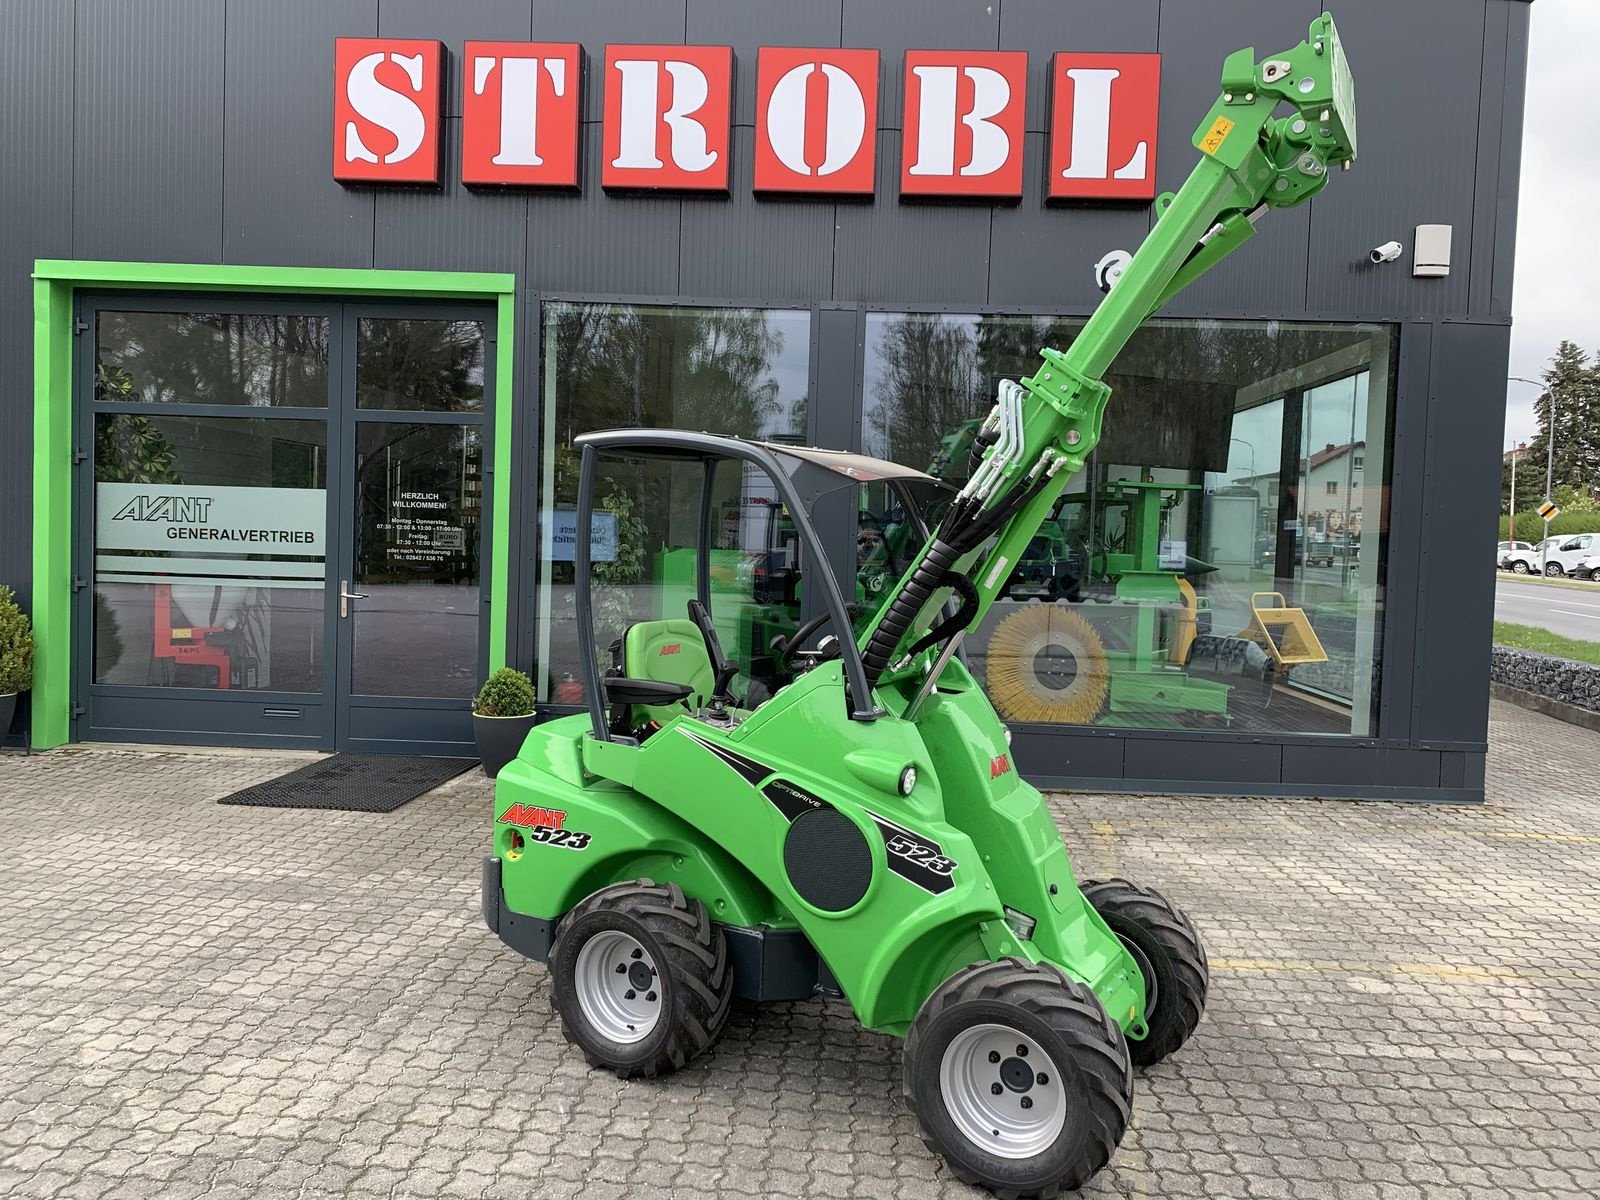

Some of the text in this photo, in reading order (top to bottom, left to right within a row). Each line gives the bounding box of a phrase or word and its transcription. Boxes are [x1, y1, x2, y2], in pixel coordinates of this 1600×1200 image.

[346, 52, 1148, 179] STROBL
[112, 495, 212, 523] AVANT
[392, 501, 447, 509] WILLKOMMEN!
[401, 492, 439, 500] HERZLICH
[391, 517, 412, 525] Montag
[166, 527, 315, 543] GENERALVERTRIEB
[414, 549, 451, 557] Vereinbarung
[771, 780, 822, 808] OPTIDRIVE
[496, 802, 567, 830] AVANT
[530, 824, 593, 851] 523
[886, 835, 960, 876] 523
